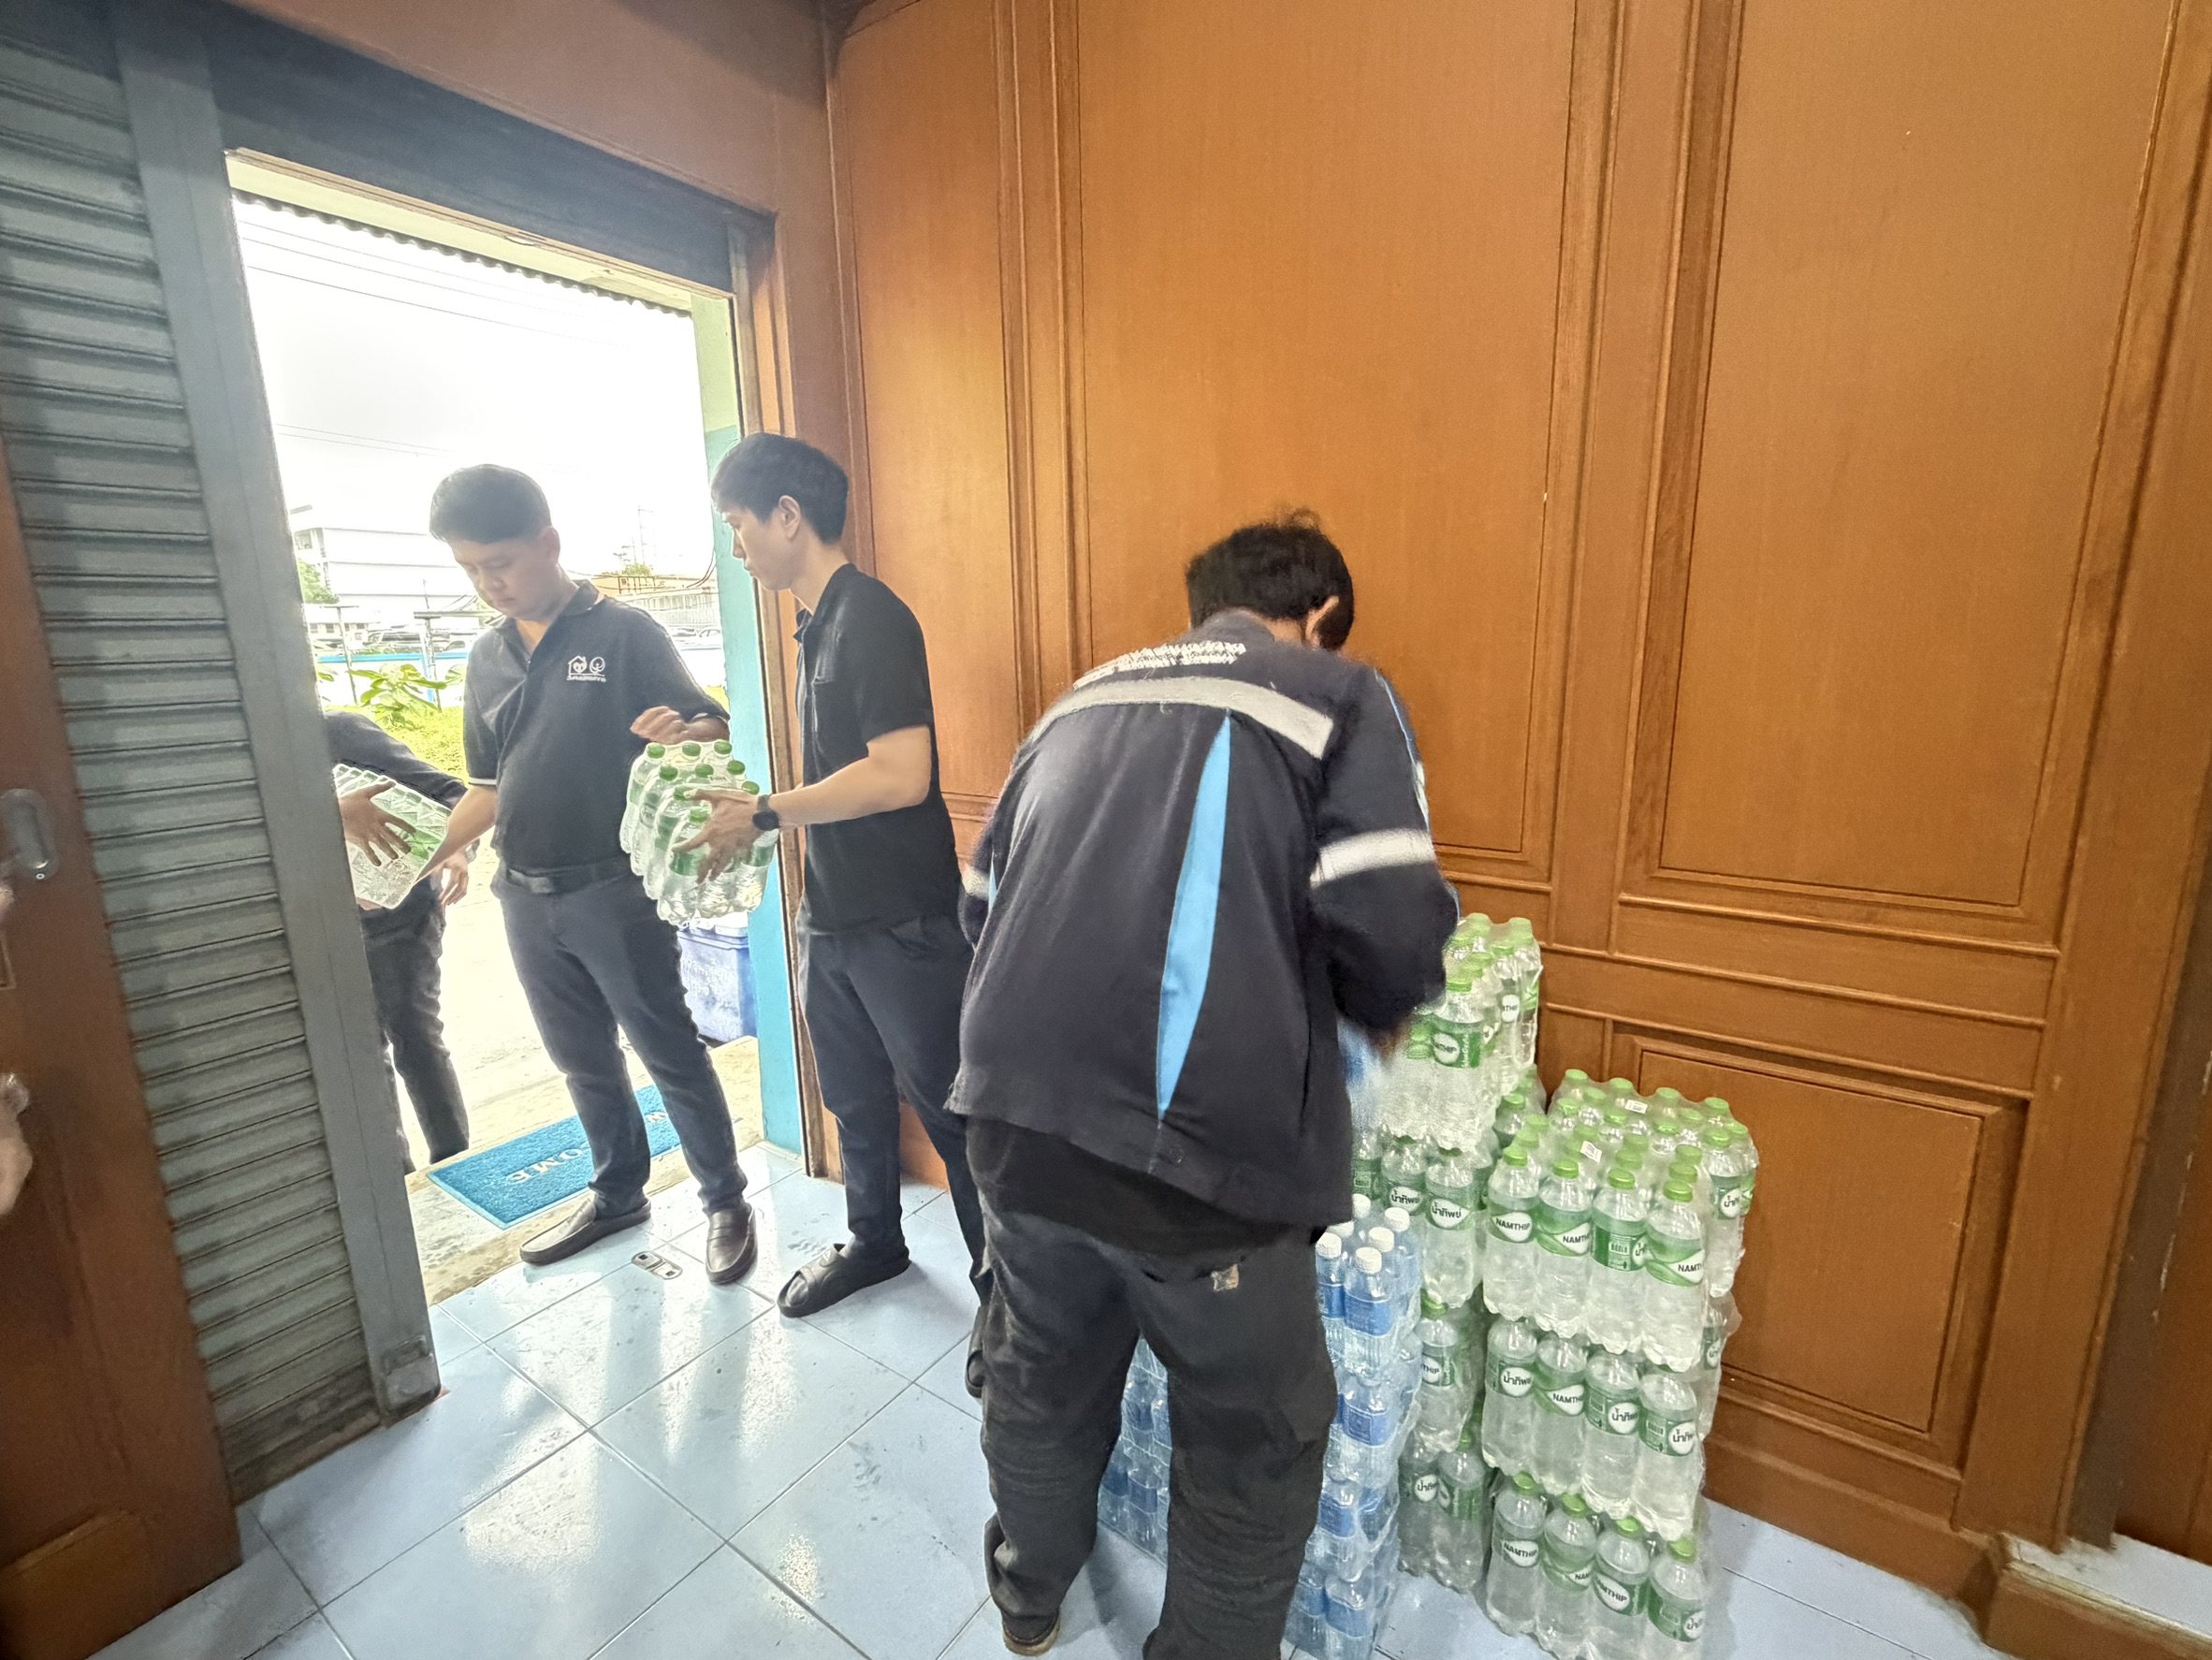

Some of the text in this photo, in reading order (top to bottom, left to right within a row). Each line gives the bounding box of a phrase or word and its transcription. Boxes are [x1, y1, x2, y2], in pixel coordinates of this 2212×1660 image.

[1495, 1218, 1531, 1230] NAMTHIP
[1563, 1233, 1591, 1244] NAMTH
[1678, 1262, 1702, 1273] NAMT
[1421, 1363, 1440, 1375] THIP
[1553, 1393, 1583, 1404] NAMTH
